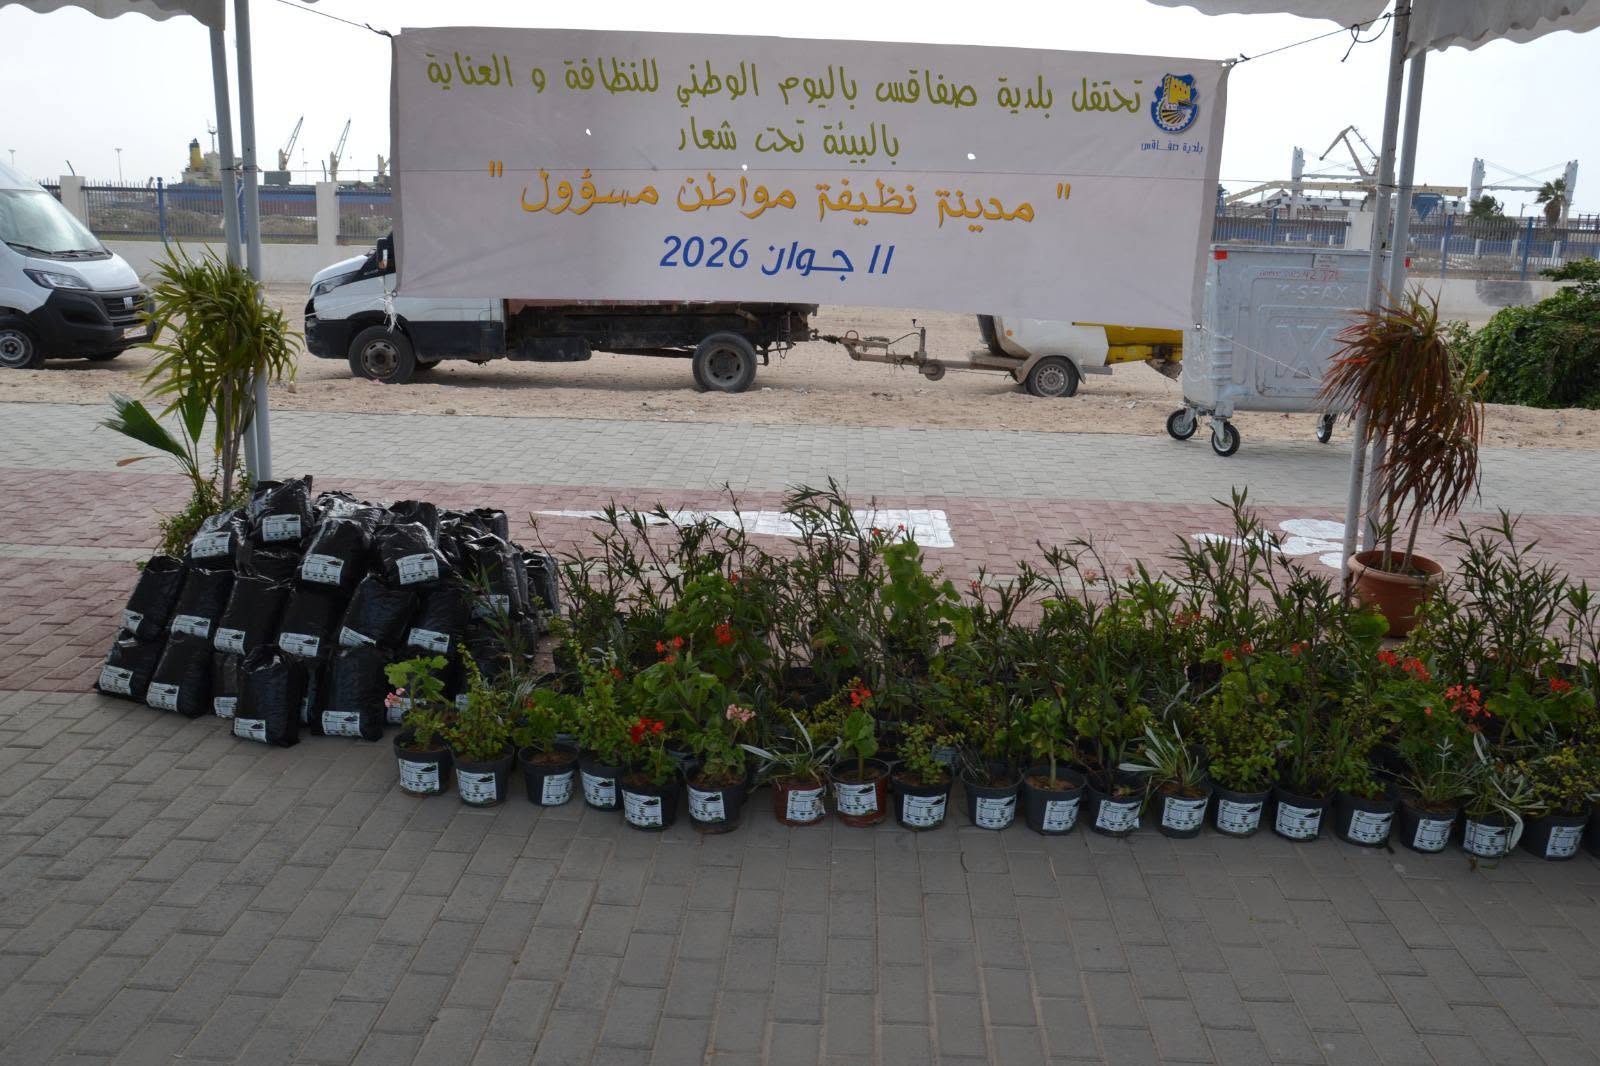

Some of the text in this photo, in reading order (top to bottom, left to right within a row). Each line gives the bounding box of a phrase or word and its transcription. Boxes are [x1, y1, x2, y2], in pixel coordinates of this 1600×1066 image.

[426, 52, 1142, 119] تحتفل بلدية صفاقس باليوم الوطني للنظافة و العناية
[679, 115, 900, 165] بالبيئة تحت شعار
[520, 168, 660, 217] مسؤول
[675, 172, 797, 220] مواطن
[815, 177, 918, 226] نظيفة
[934, 188, 1036, 233] مدينة
[659, 235, 750, 270] 2026
